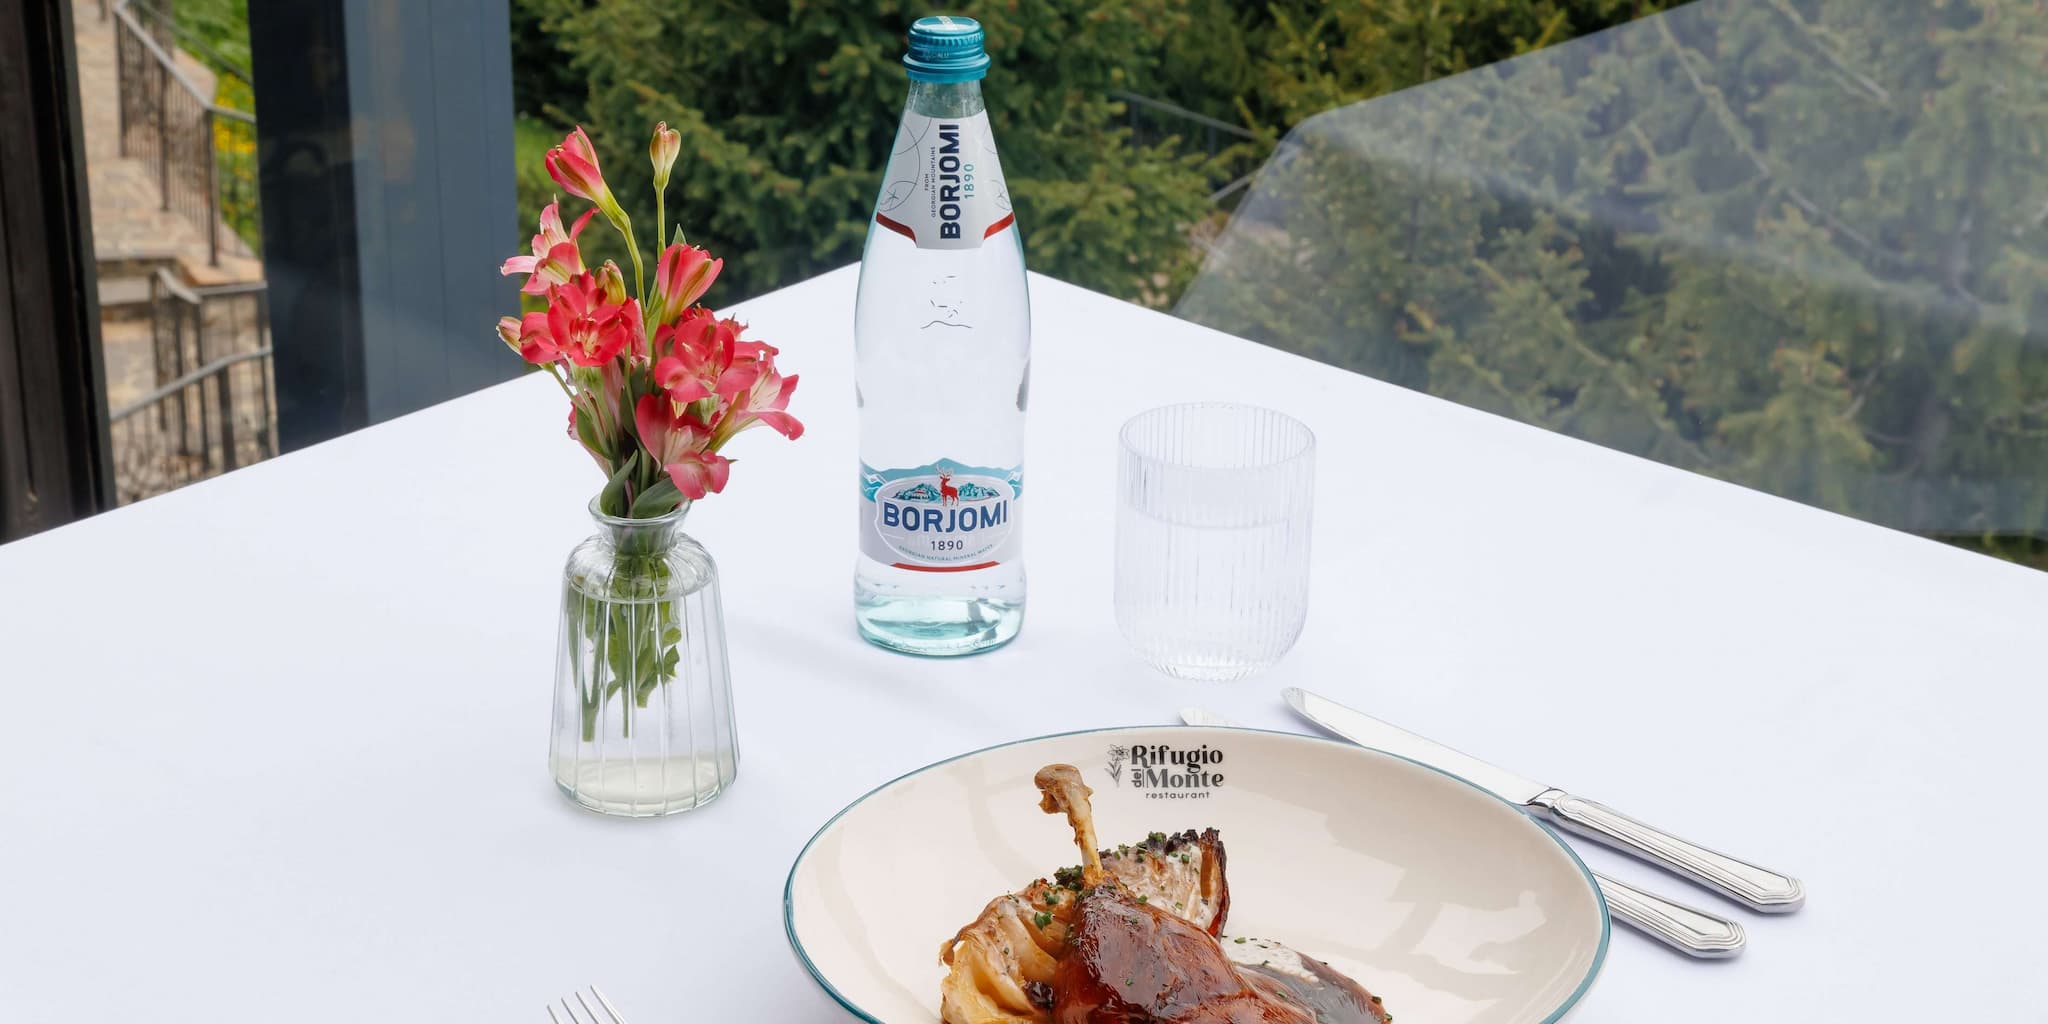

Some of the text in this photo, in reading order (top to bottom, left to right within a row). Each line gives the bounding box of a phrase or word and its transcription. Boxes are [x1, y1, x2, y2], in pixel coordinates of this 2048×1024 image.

[939, 124, 961, 240] BORJOMI
[964, 163, 975, 199] 1890
[883, 500, 1008, 533] BORJOMI
[931, 540, 964, 551] 1890
[953, 552, 977, 560] MINERAL
[1131, 744, 1223, 773] Rifugio
[1131, 769, 1142, 788] del
[1146, 768, 1224, 788] Monte
[1146, 791, 1210, 799] restaurant
